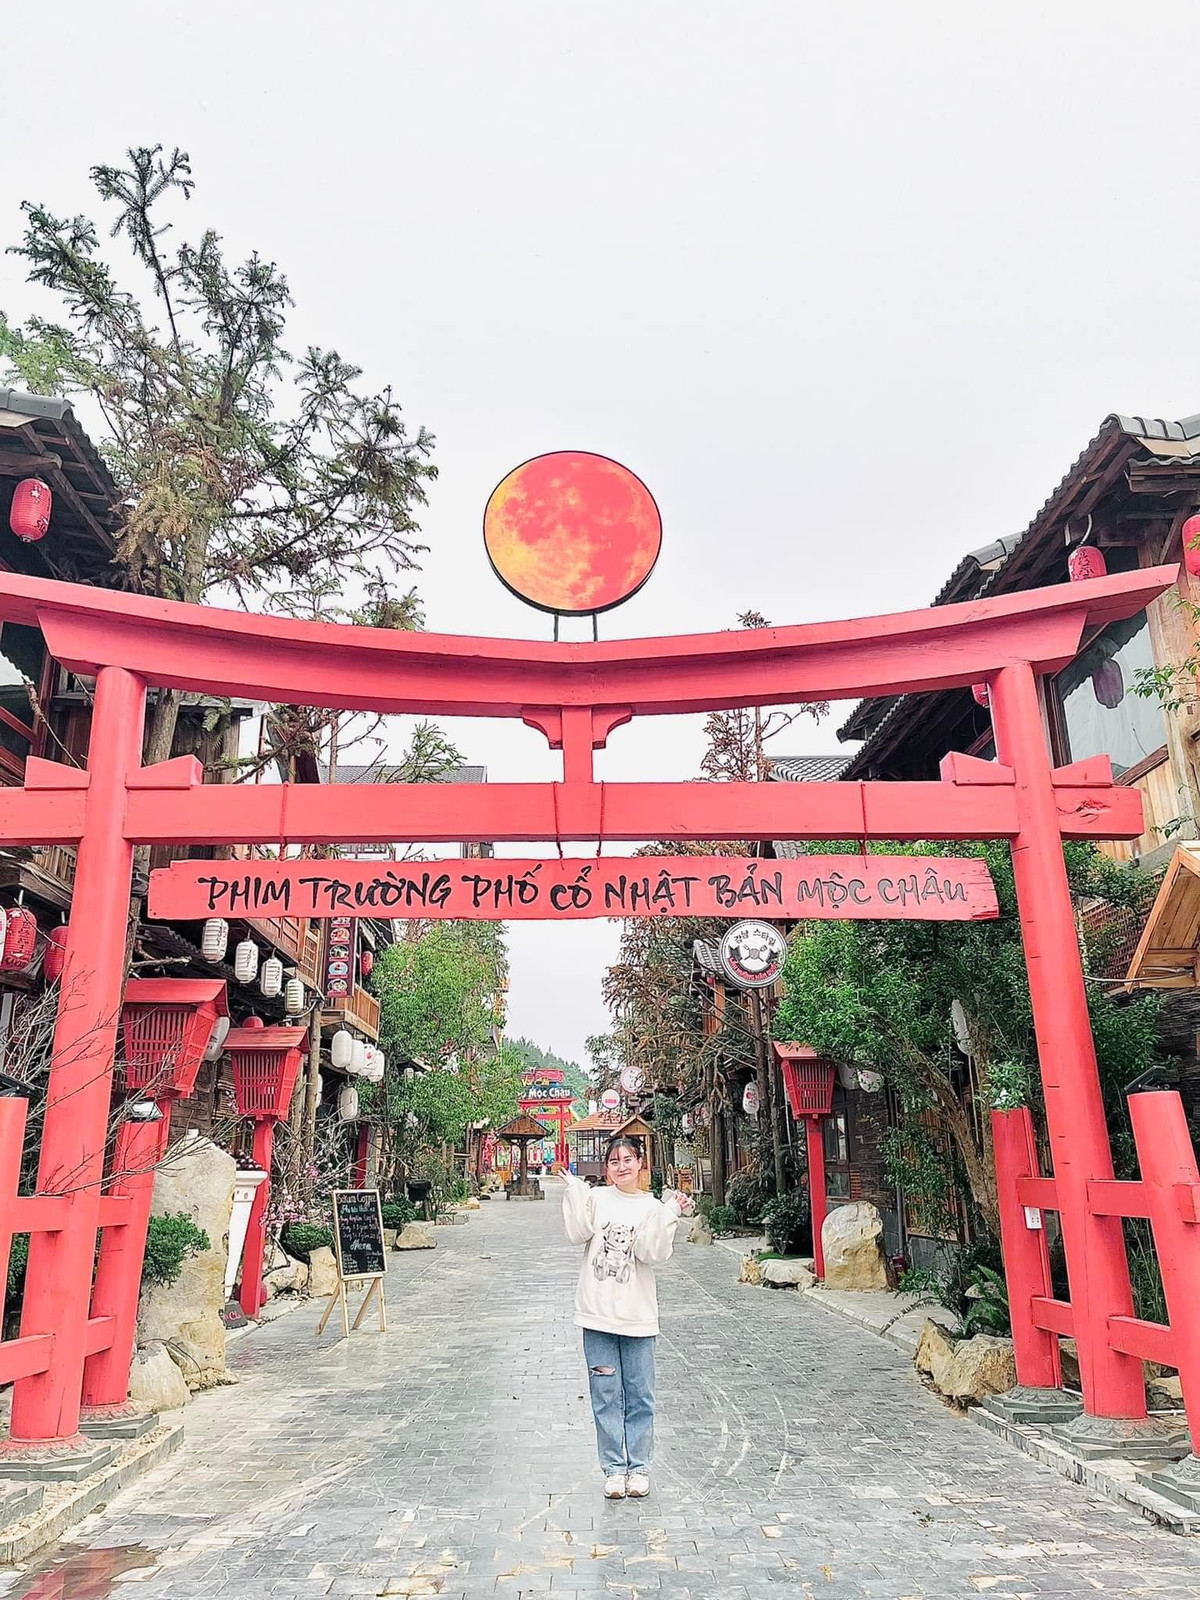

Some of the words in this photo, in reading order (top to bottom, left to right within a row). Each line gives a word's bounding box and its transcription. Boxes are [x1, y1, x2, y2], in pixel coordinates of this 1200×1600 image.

[198, 876, 291, 909] PHIM
[299, 871, 451, 908] TRƯỜNG
[461, 863, 541, 908] PHỐ
[550, 866, 593, 911] CỔ
[604, 870, 701, 913] NHẬT
[709, 863, 782, 908] BẢN
[797, 872, 871, 909] MỘC
[753, 928, 776, 946] 스타일
